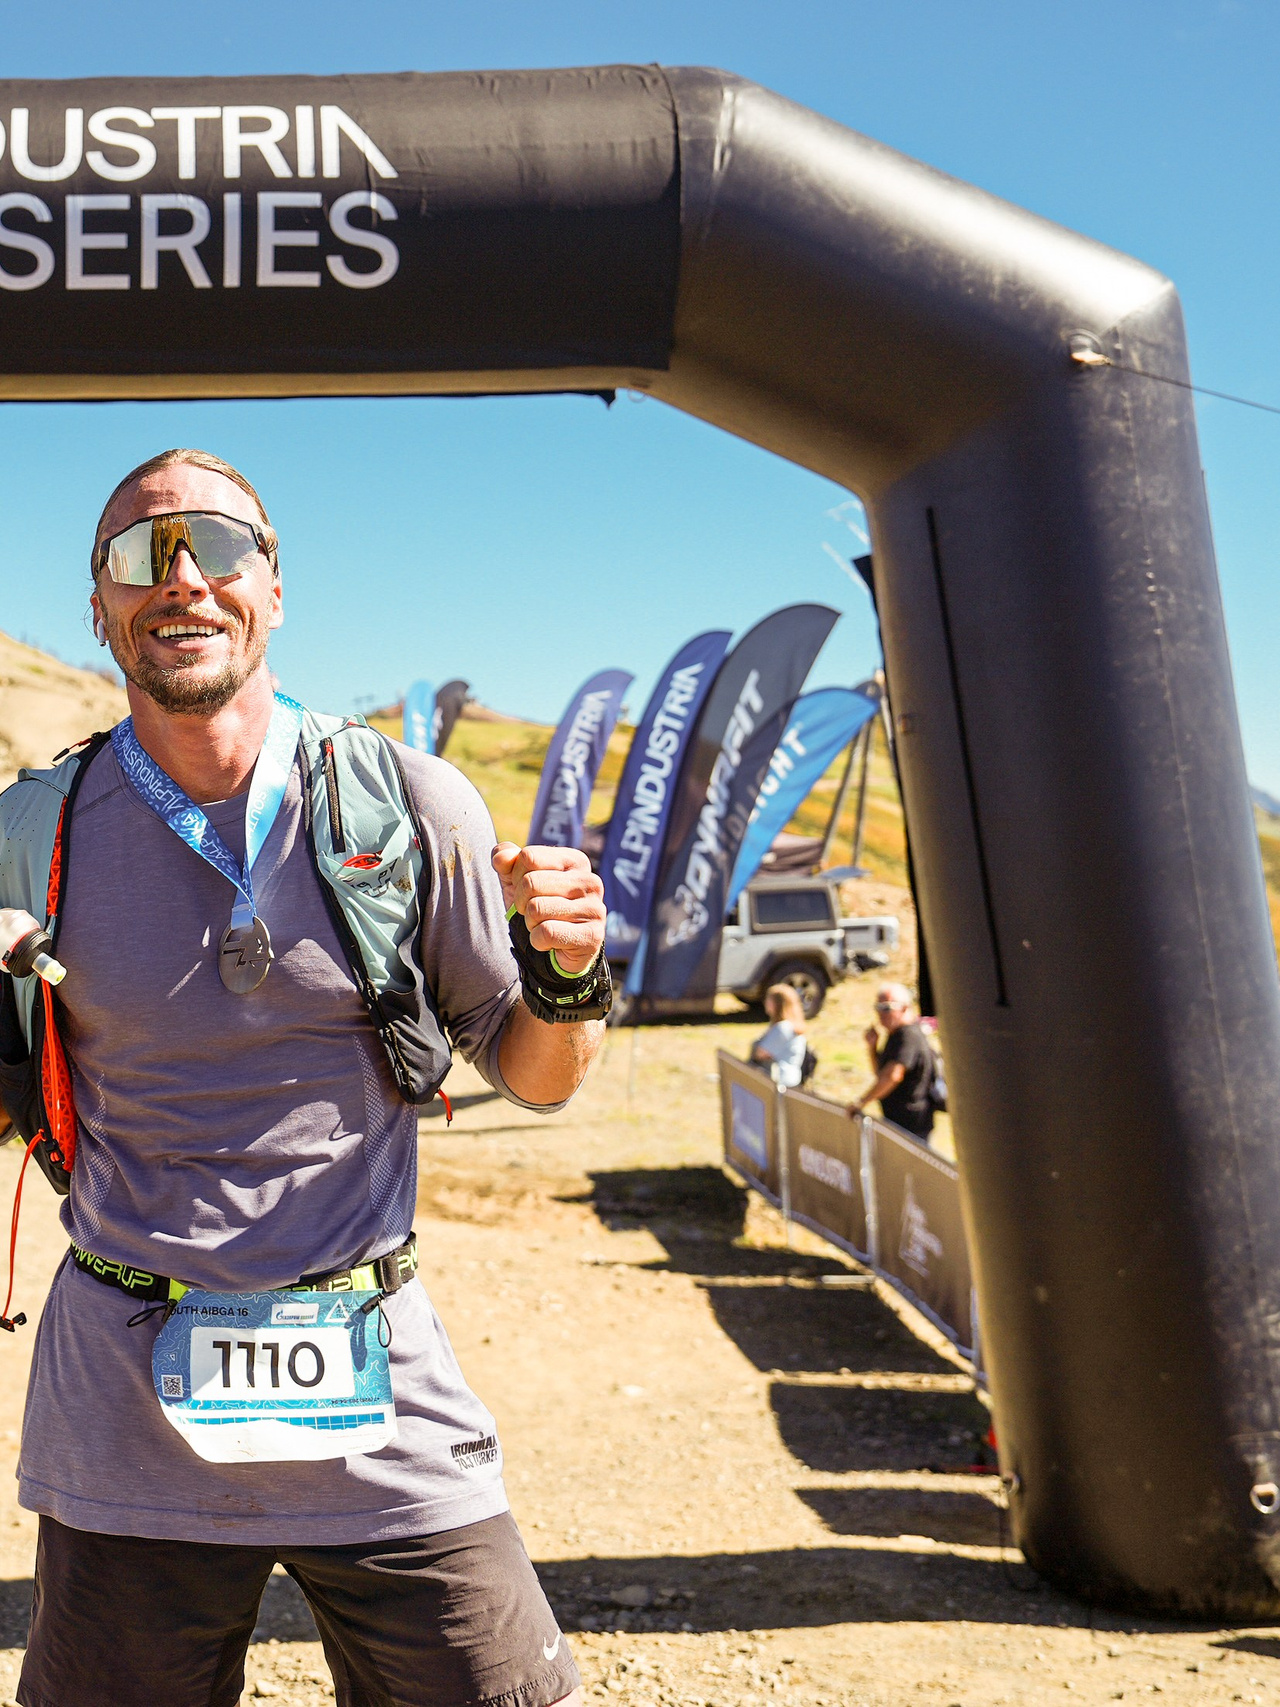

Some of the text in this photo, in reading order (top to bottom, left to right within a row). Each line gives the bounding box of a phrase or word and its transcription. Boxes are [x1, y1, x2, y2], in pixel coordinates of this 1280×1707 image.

[542, 688, 613, 847] PINDUSTRIA
[613, 662, 705, 898] ALPINDUSTRIA
[685, 668, 764, 901] DYNAFIT
[538, 977, 598, 1005] LEKI
[170, 1305, 249, 1317] OUTH AIBGA 16
[212, 1340, 326, 1389] 1110
